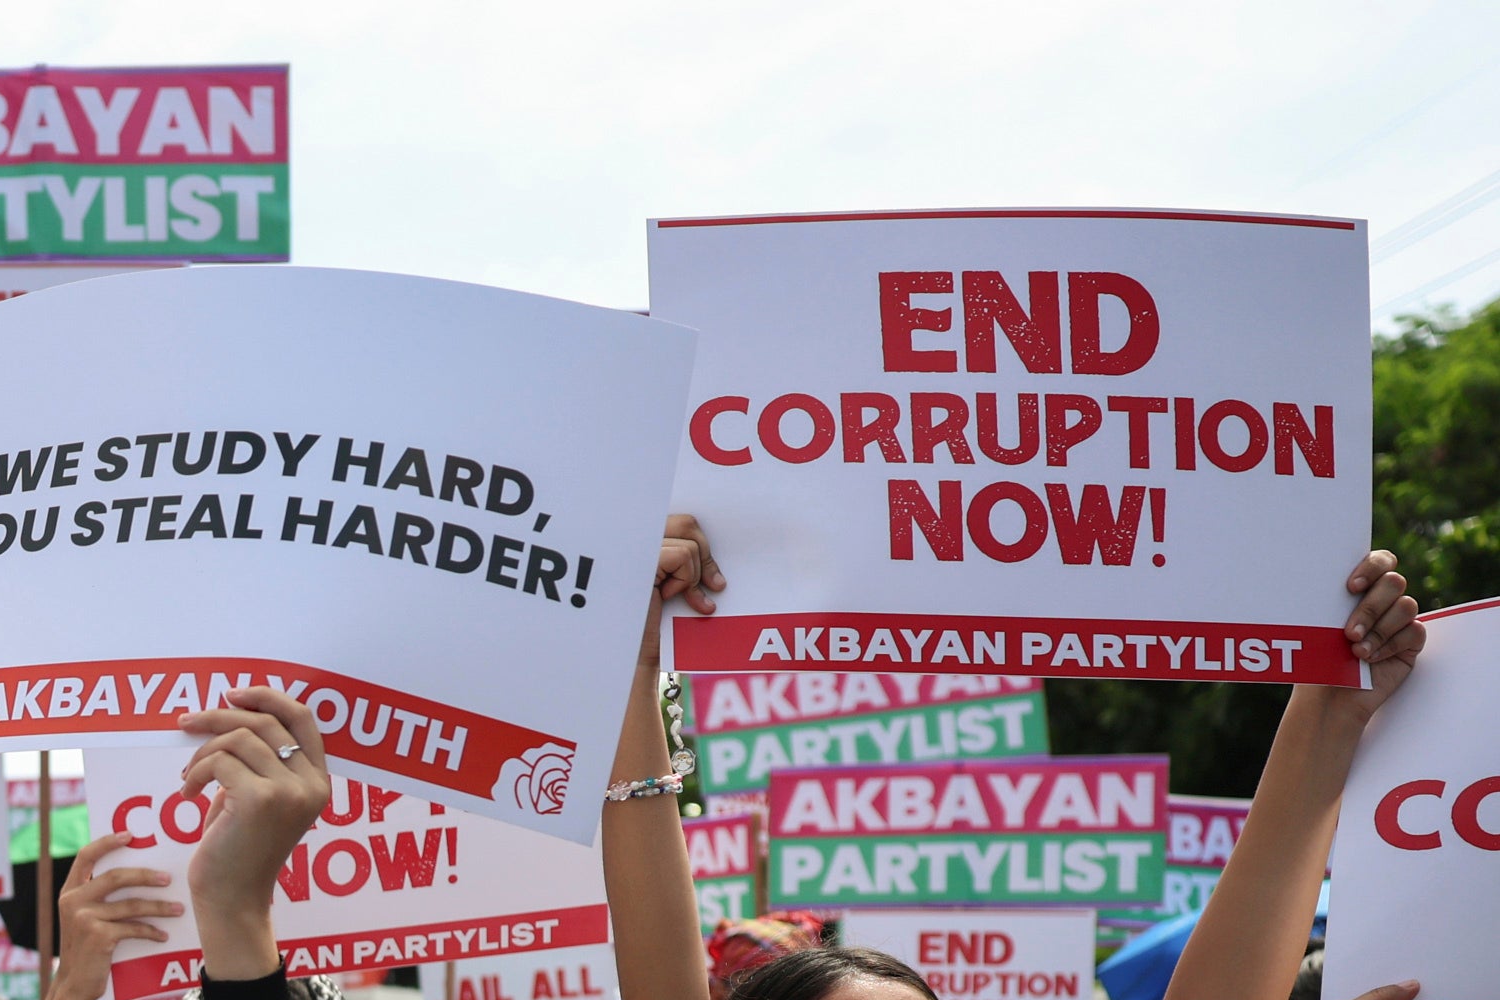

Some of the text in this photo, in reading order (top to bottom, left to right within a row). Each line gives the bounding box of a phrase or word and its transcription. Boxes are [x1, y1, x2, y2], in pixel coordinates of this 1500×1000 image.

[878, 271, 1160, 376] END
[689, 392, 1335, 478] CORRUPTION
[94, 431, 319, 482] STUDY
[332, 438, 553, 532] HARD,
[70, 493, 262, 546] STEAL
[280, 498, 594, 609] HARDER!
[887, 479, 1167, 568] NOW!
[749, 627, 1302, 674] AKBAYAN PARTYLIST
[707, 699, 1033, 786] PARTYLIST
[781, 772, 1155, 832] AKBAYAN
[781, 841, 1151, 895] PARTYLIST
[354, 920, 559, 964] PARTYLIST
[918, 931, 1014, 965] END
[532, 965, 603, 1000] ALL
[927, 972, 1078, 998] RUPTION
